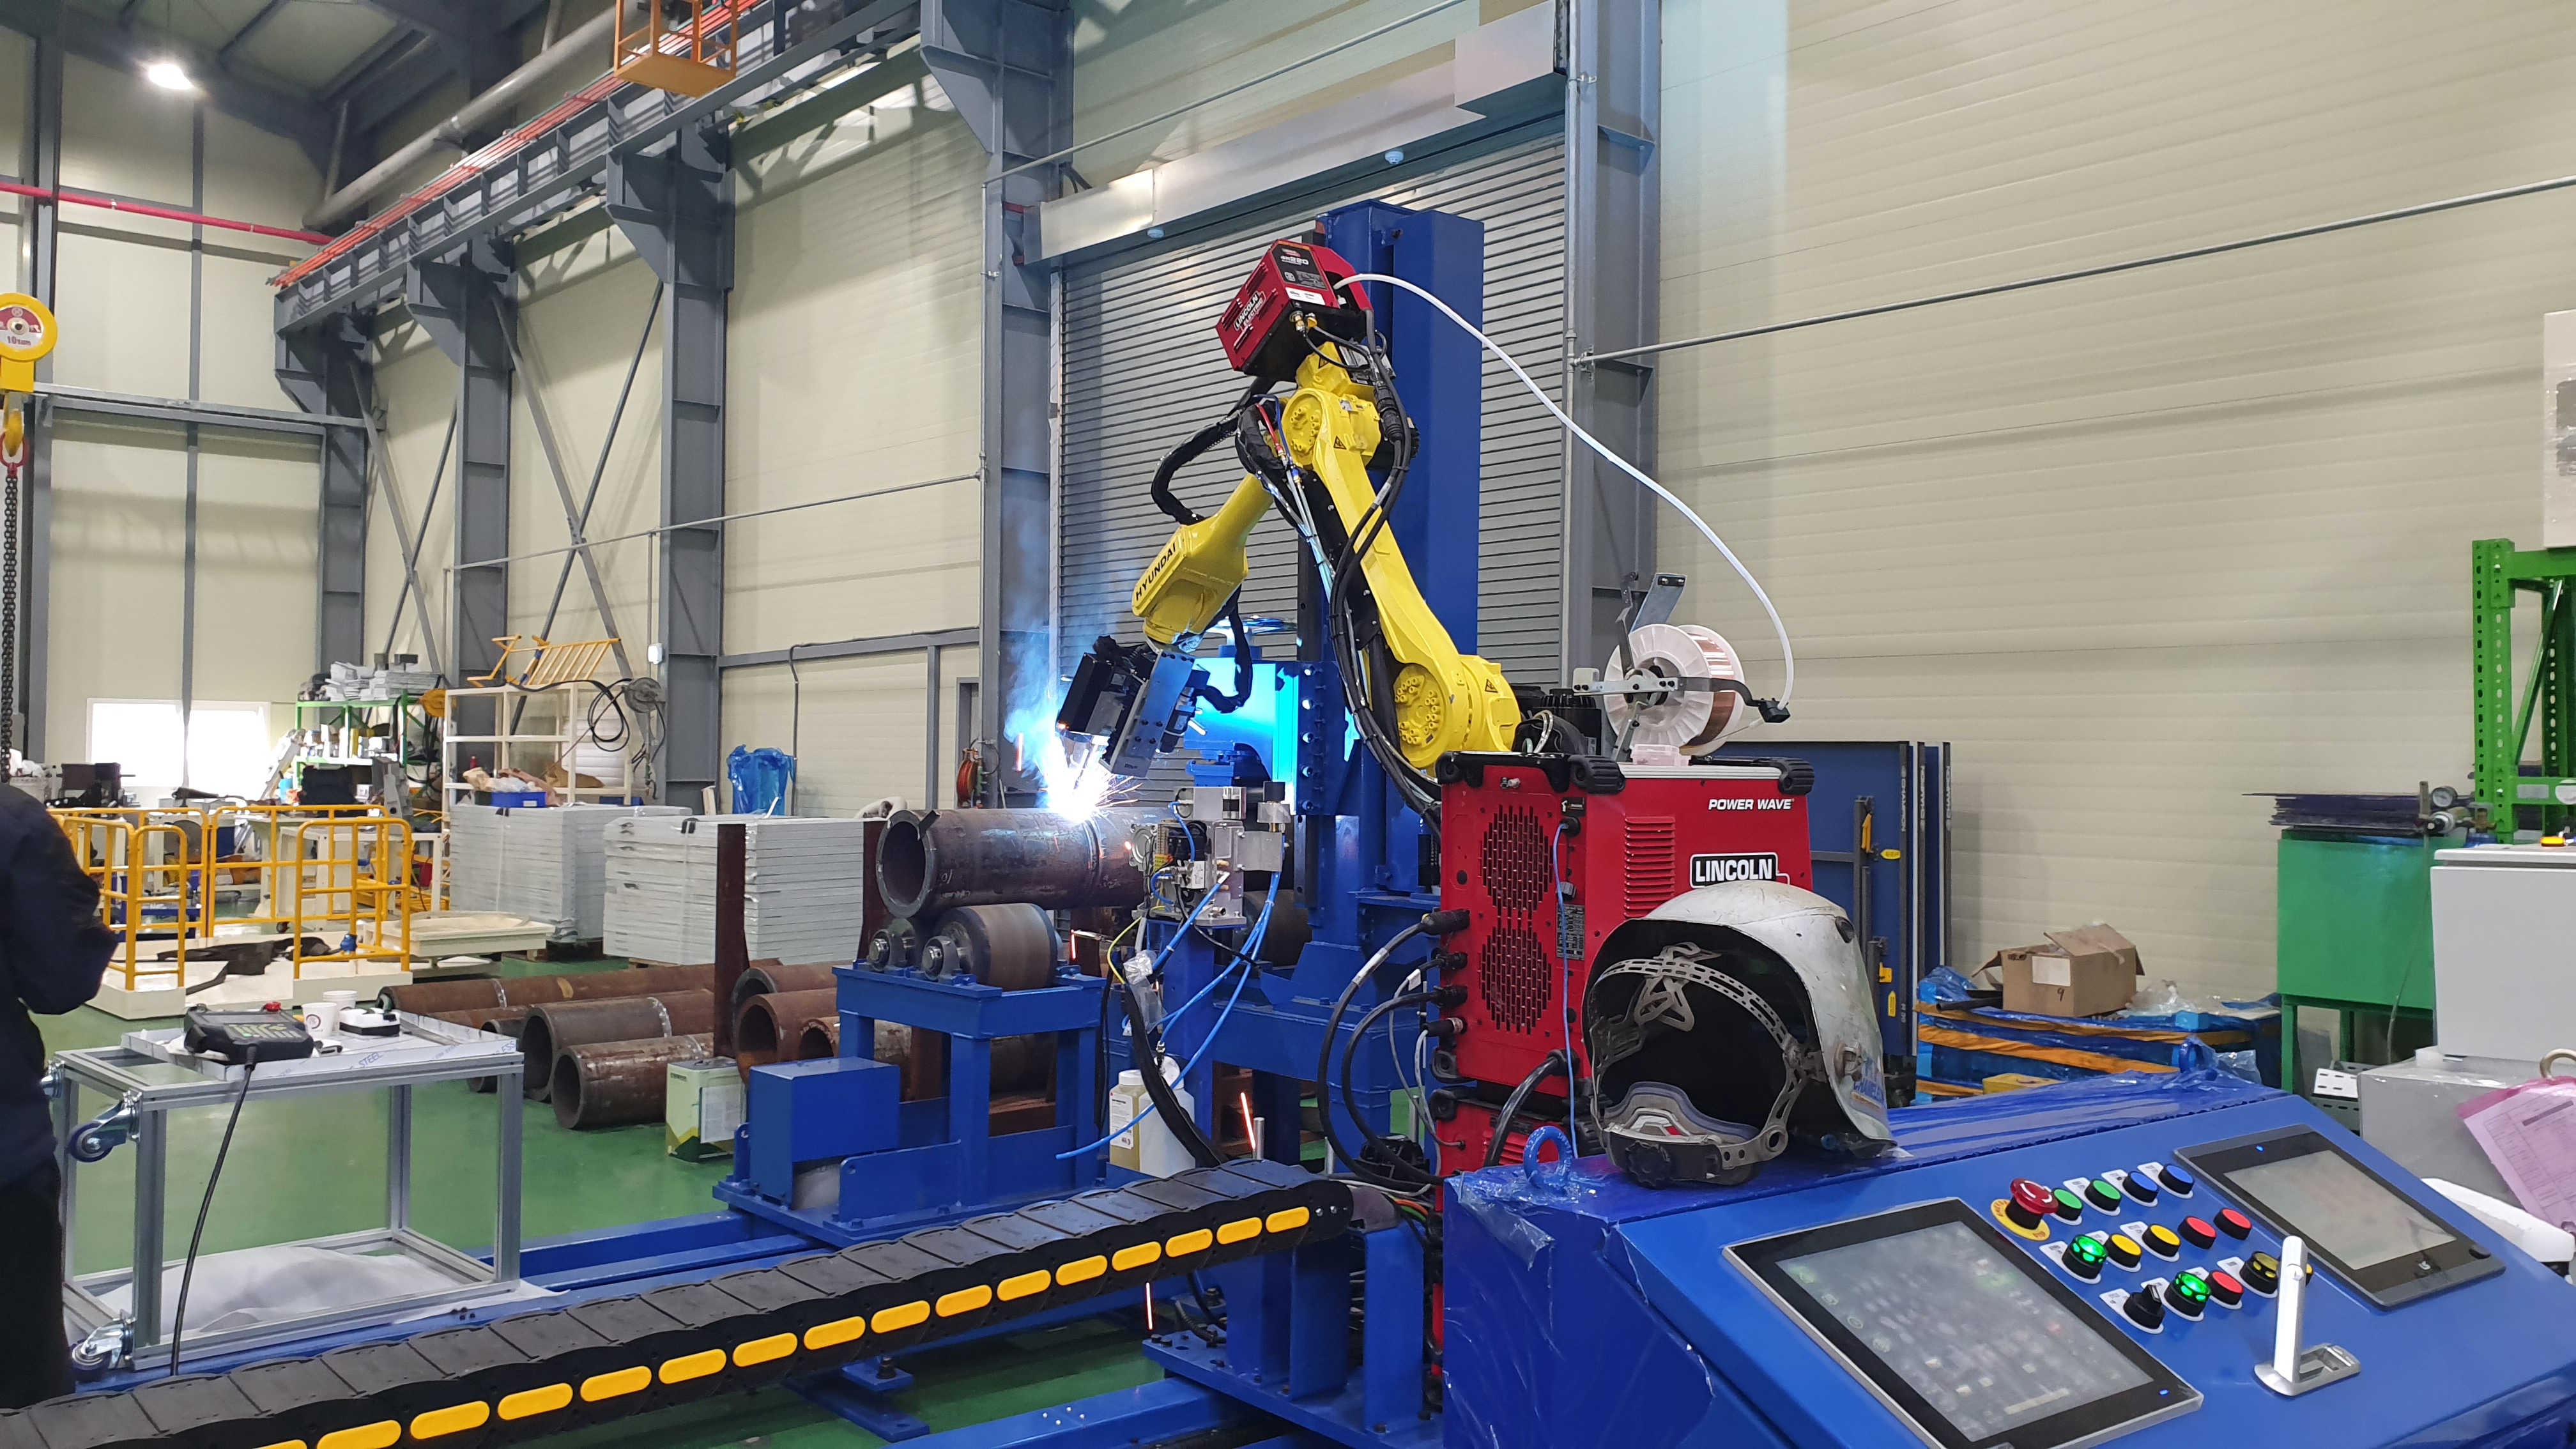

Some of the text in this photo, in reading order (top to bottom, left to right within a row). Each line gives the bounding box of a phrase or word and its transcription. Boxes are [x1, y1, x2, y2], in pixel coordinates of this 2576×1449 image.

[1235, 294, 1259, 328] LINCOLN
[1243, 297, 1263, 327] ELECTRIC
[1135, 542, 1176, 601] HYUNDAI
[1708, 799, 1793, 810] POWER WAVE
[1695, 858, 1773, 883] LINCOLN
[358, 1052, 383, 1068] STEEL
